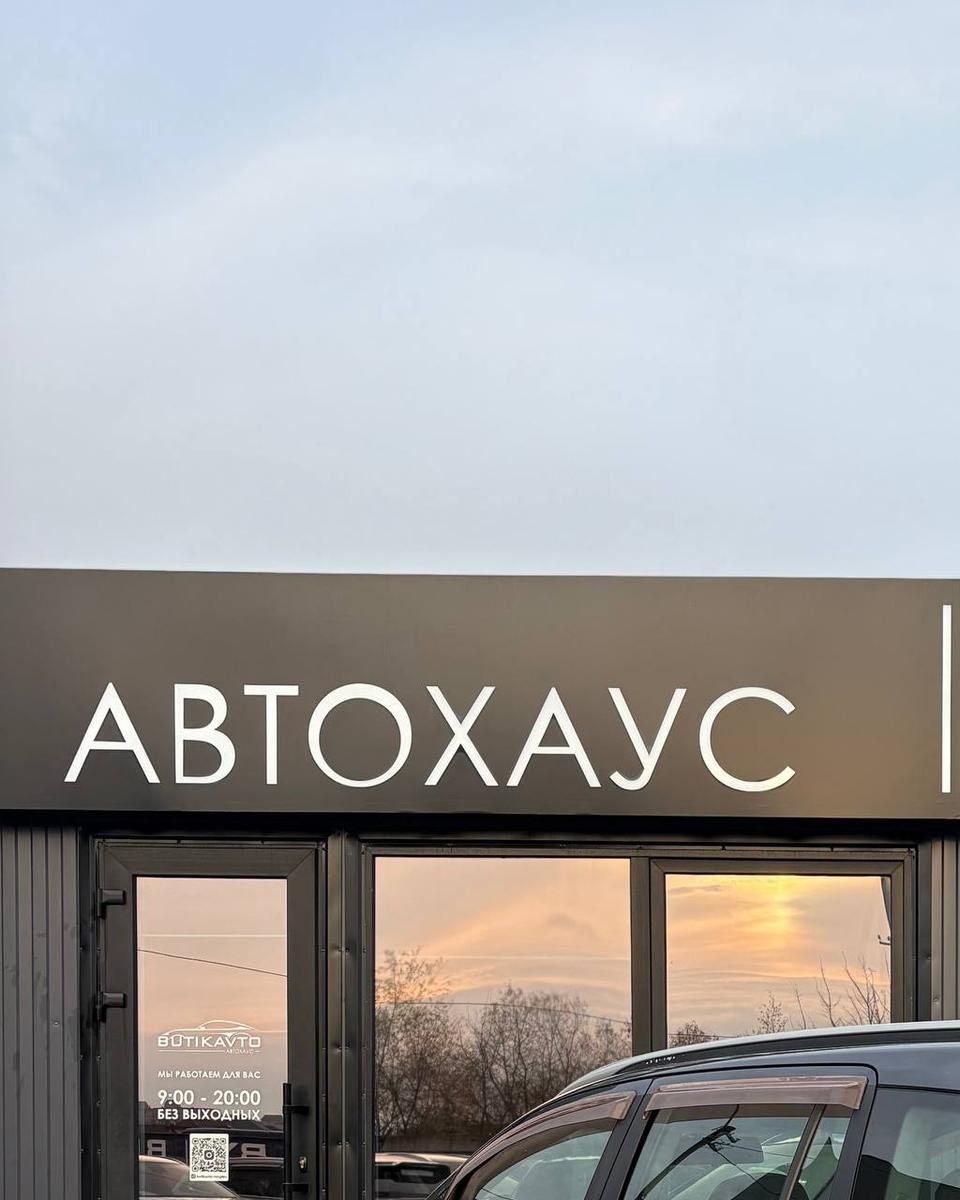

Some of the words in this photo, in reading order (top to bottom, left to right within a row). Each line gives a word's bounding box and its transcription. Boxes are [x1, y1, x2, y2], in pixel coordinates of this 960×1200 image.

[64, 681, 796, 792] АВТОХАУС
[157, 1035, 261, 1048] BUTIKAVTO
[158, 1070, 173, 1079] МЫ
[175, 1070, 221, 1079] РАБОТАЕМ
[222, 1071, 241, 1079] ДЛЯ
[242, 1071, 261, 1079] ВАС
[157, 1090, 194, 1105] 9:00
[213, 1090, 261, 1105] 20:00
[157, 1109, 179, 1120] БЕЗ
[182, 1109, 261, 1121] ВЫХОДНЫХ
